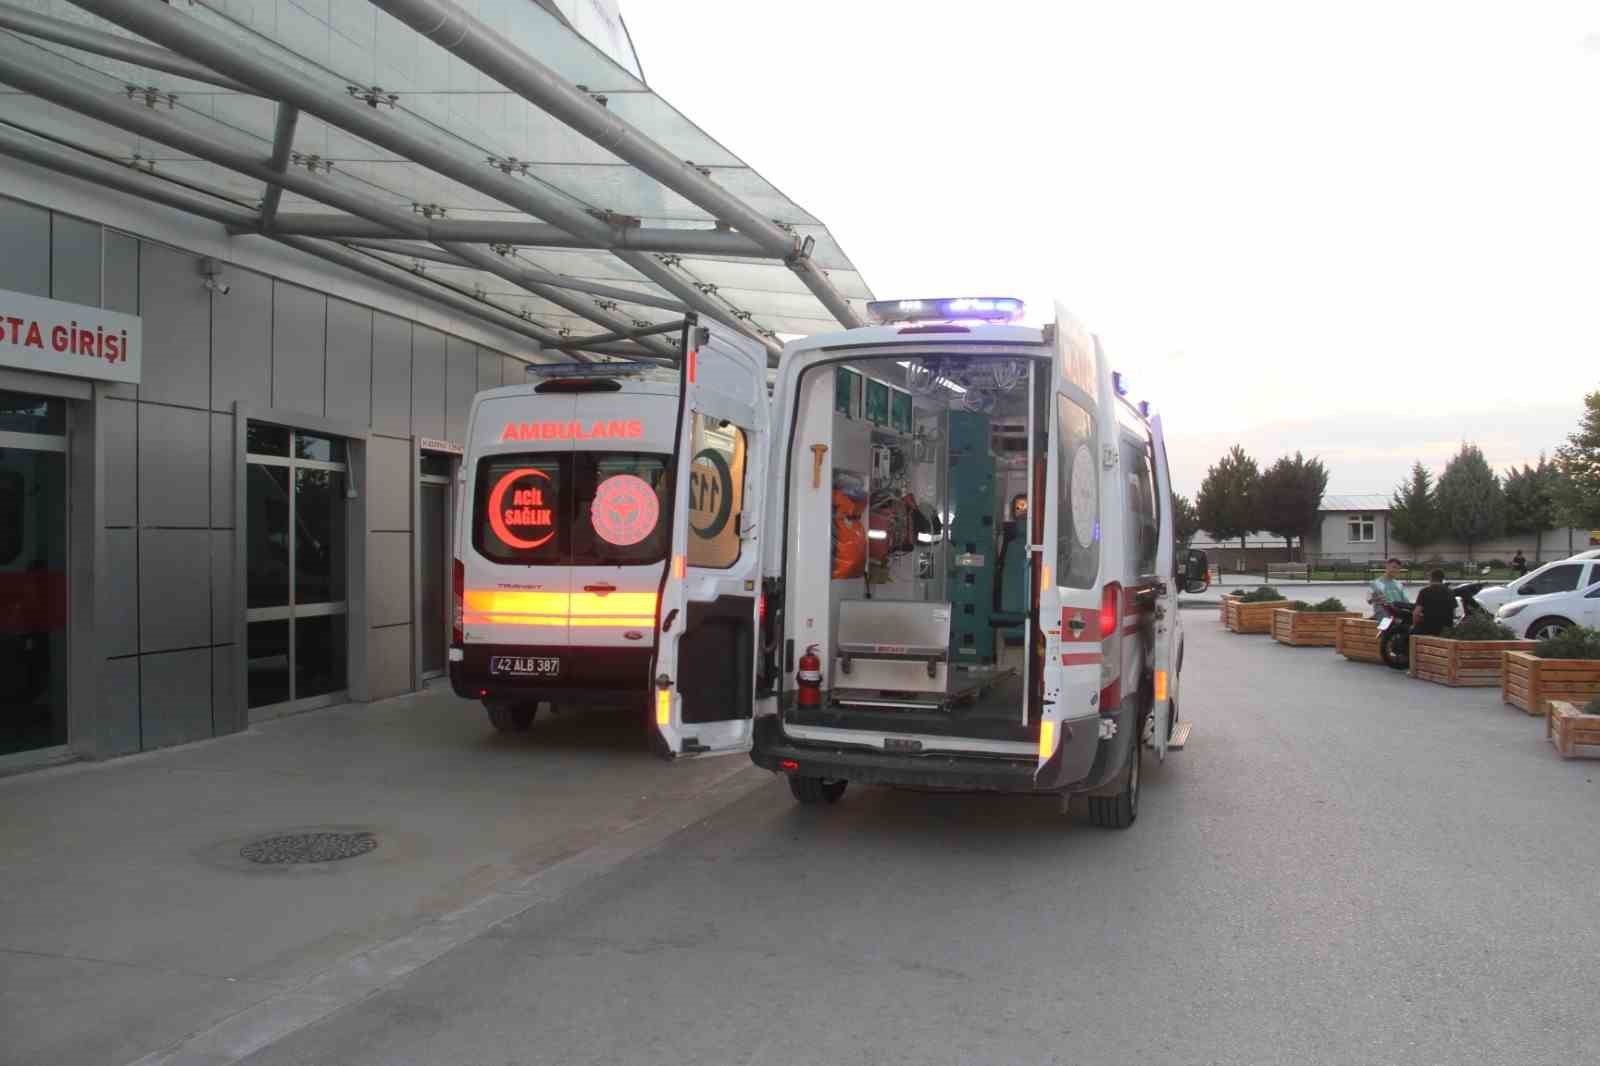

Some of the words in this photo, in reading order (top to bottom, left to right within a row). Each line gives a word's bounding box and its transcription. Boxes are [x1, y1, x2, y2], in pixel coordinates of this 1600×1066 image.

[51, 320, 127, 363] GİRİŞİ
[502, 420, 643, 440] AMBULANS
[513, 487, 542, 506] ACİL
[504, 504, 551, 526] SAĞLIK
[497, 658, 512, 672] 42
[513, 658, 534, 673] ALB
[536, 659, 558, 673] 387
